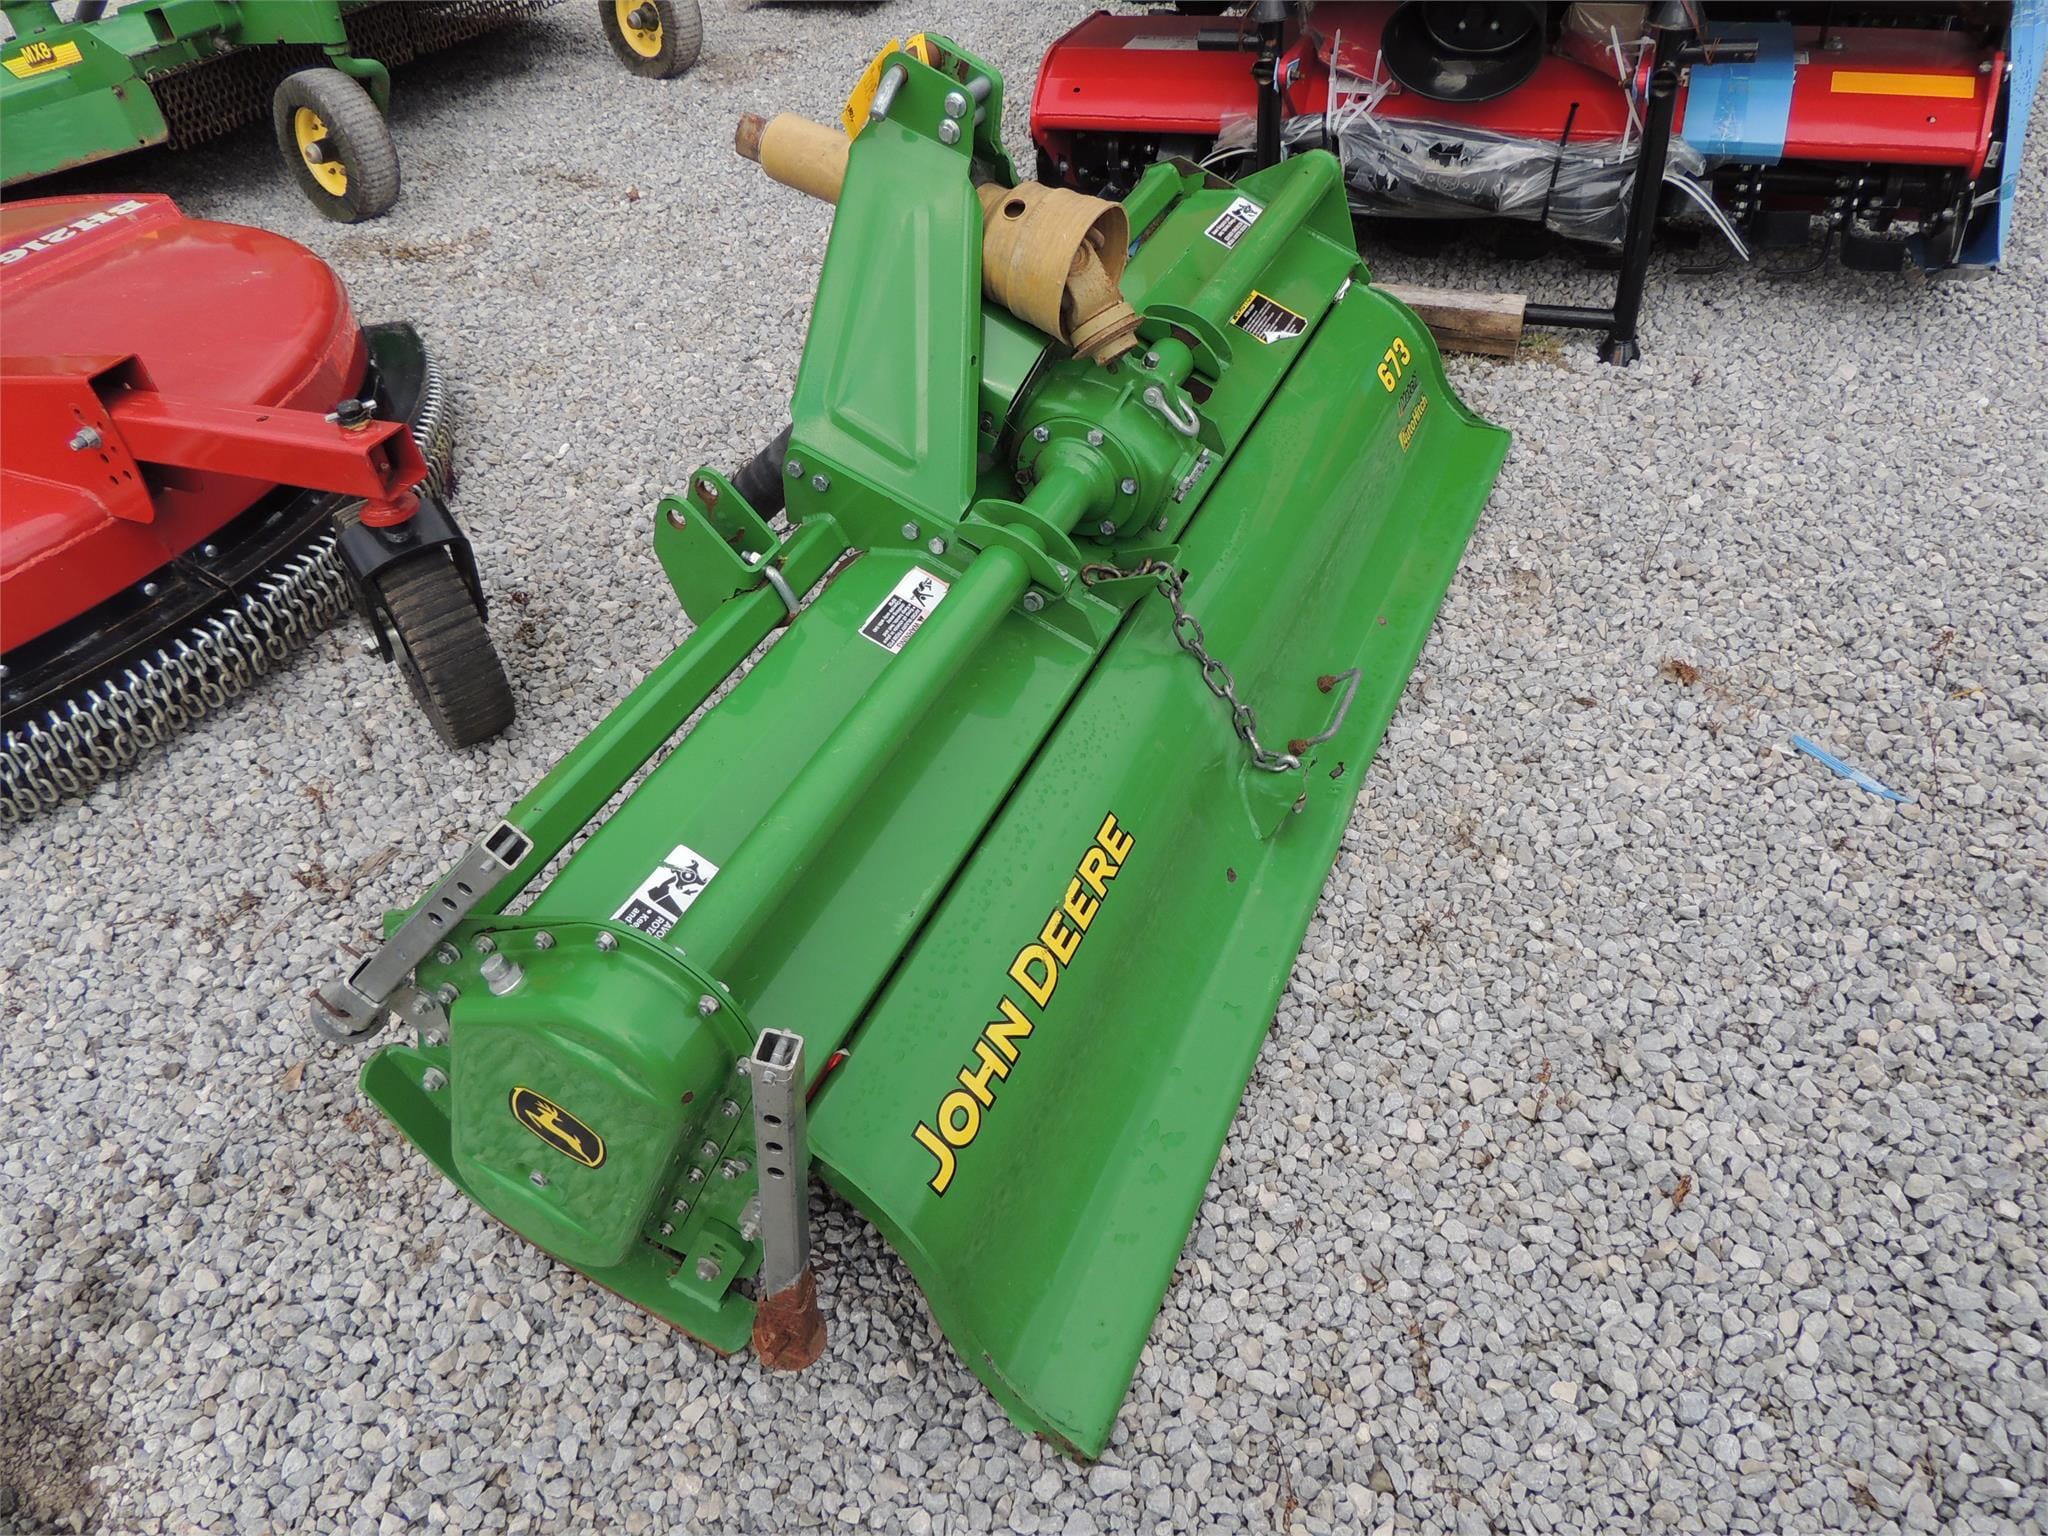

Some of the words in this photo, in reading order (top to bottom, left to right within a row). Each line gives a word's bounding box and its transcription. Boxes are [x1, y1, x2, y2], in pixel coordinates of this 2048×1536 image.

[20, 40, 54, 65] MX8
[1377, 336, 1411, 393] 673
[624, 907, 640, 924] and
[630, 913, 650, 928] Kee
[911, 994, 1035, 1198] JOHN
[1007, 810, 1136, 1012] DEERE
